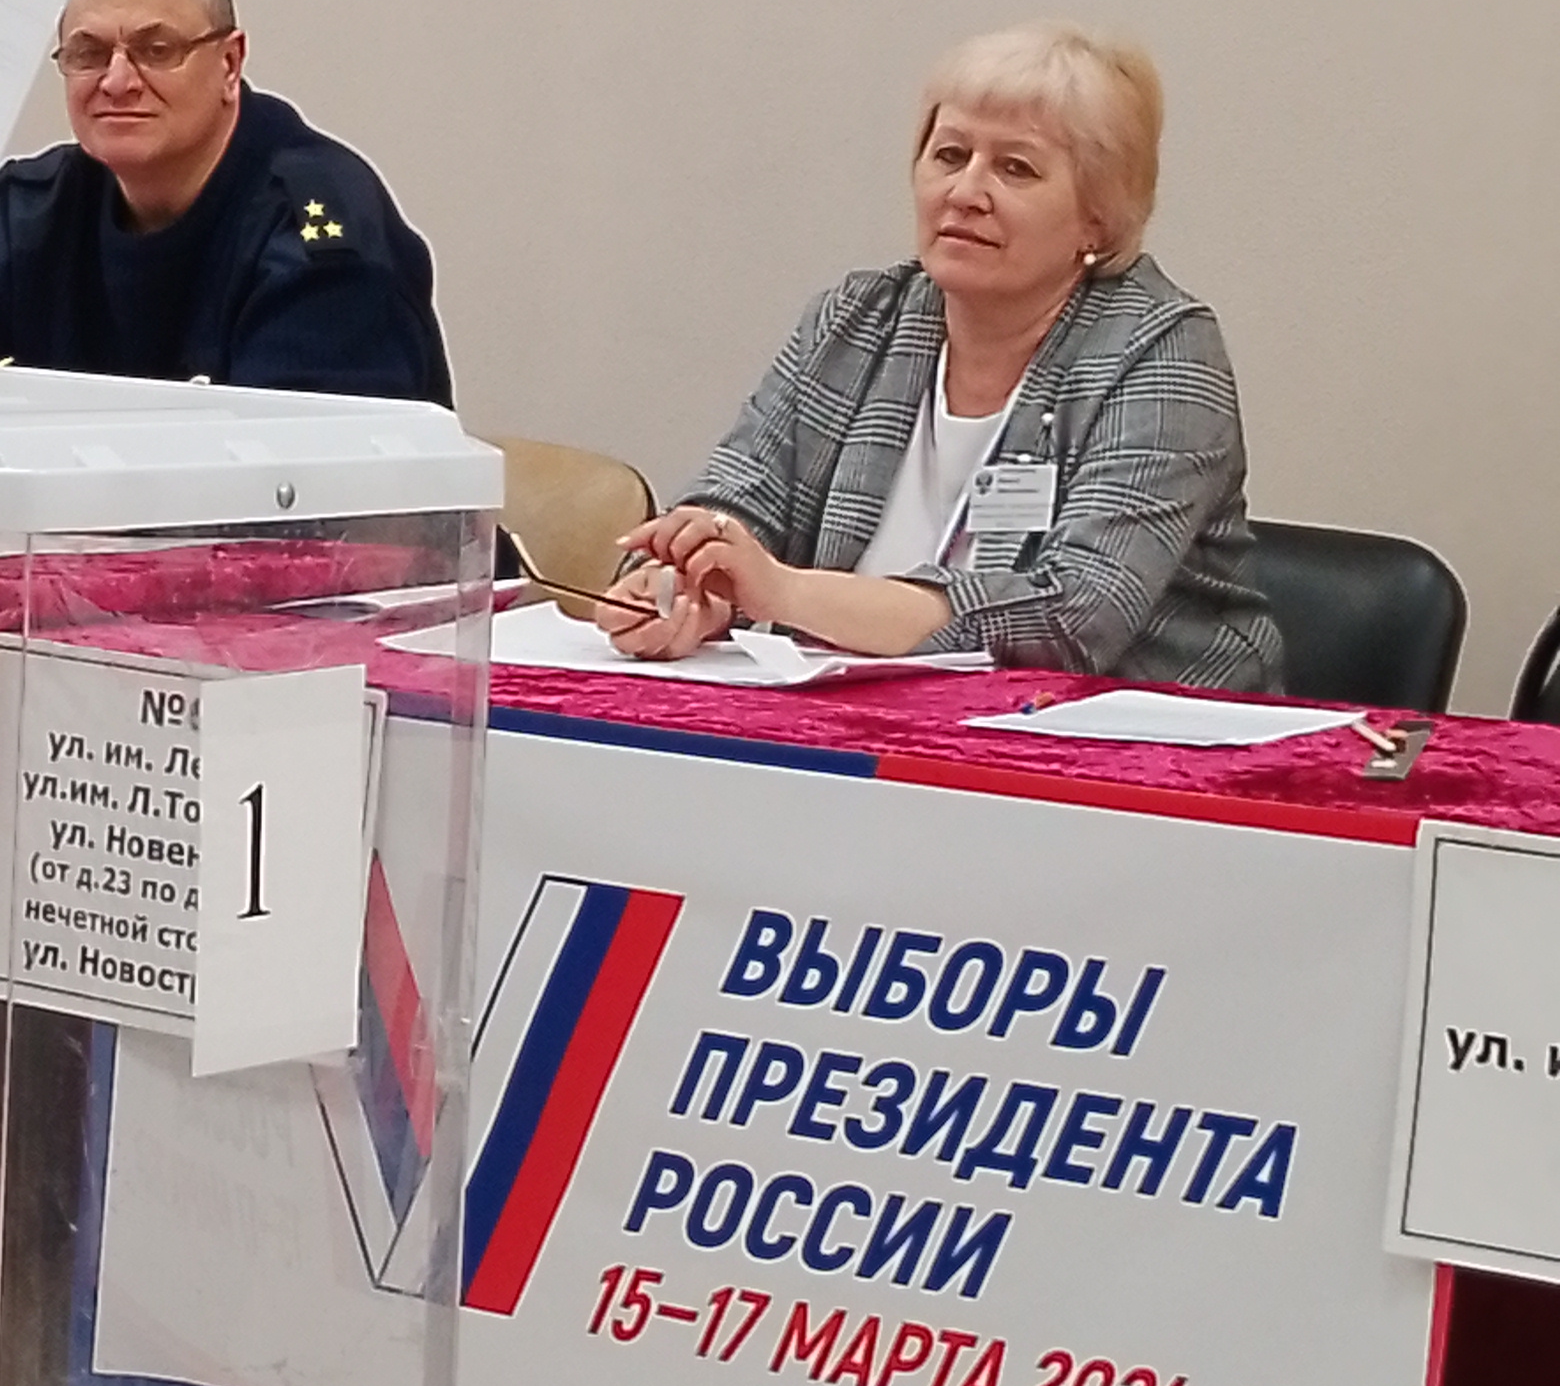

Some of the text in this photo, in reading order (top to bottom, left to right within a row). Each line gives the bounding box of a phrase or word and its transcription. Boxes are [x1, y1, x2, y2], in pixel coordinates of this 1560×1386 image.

[48, 731, 94, 762] ул.
[104, 740, 154, 772] им.
[23, 770, 119, 810] ул.им.
[51, 819, 95, 850] ул.
[237, 782, 271, 919] 1
[30, 851, 71, 884] (от
[75, 866, 132, 896] д.23
[141, 878, 177, 903] по
[24, 898, 149, 944] нечетной
[23, 939, 68, 971] ул.
[719, 908, 1167, 1058] ВЫБОРЫ
[1447, 1026, 1526, 1073] ул.
[668, 1030, 1299, 1219] ПРЕЗИДЕНТА
[622, 1150, 1014, 1300] РОССИИ
